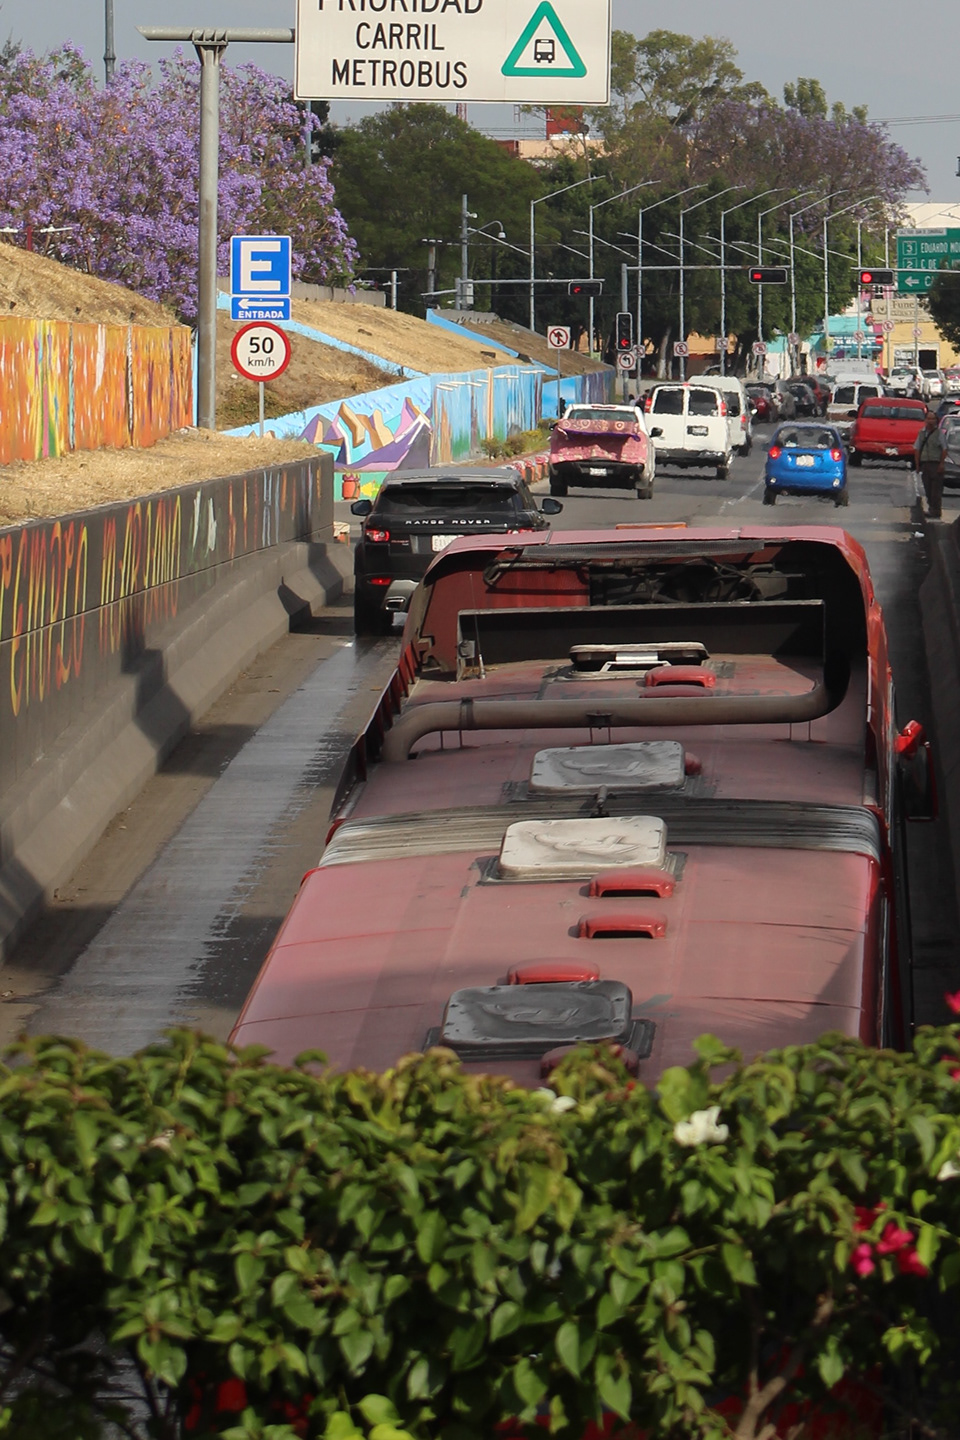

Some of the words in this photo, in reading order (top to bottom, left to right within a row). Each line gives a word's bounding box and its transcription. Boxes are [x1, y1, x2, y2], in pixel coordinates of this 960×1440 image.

[356, 22, 445, 50] CARRIL
[331, 59, 468, 89] METROBUS
[921, 242, 948, 253] EDUARDO
[240, 241, 281, 291] E
[238, 310, 284, 319] ENTRADA
[249, 337, 274, 354] 50
[247, 357, 275, 367] km/h
